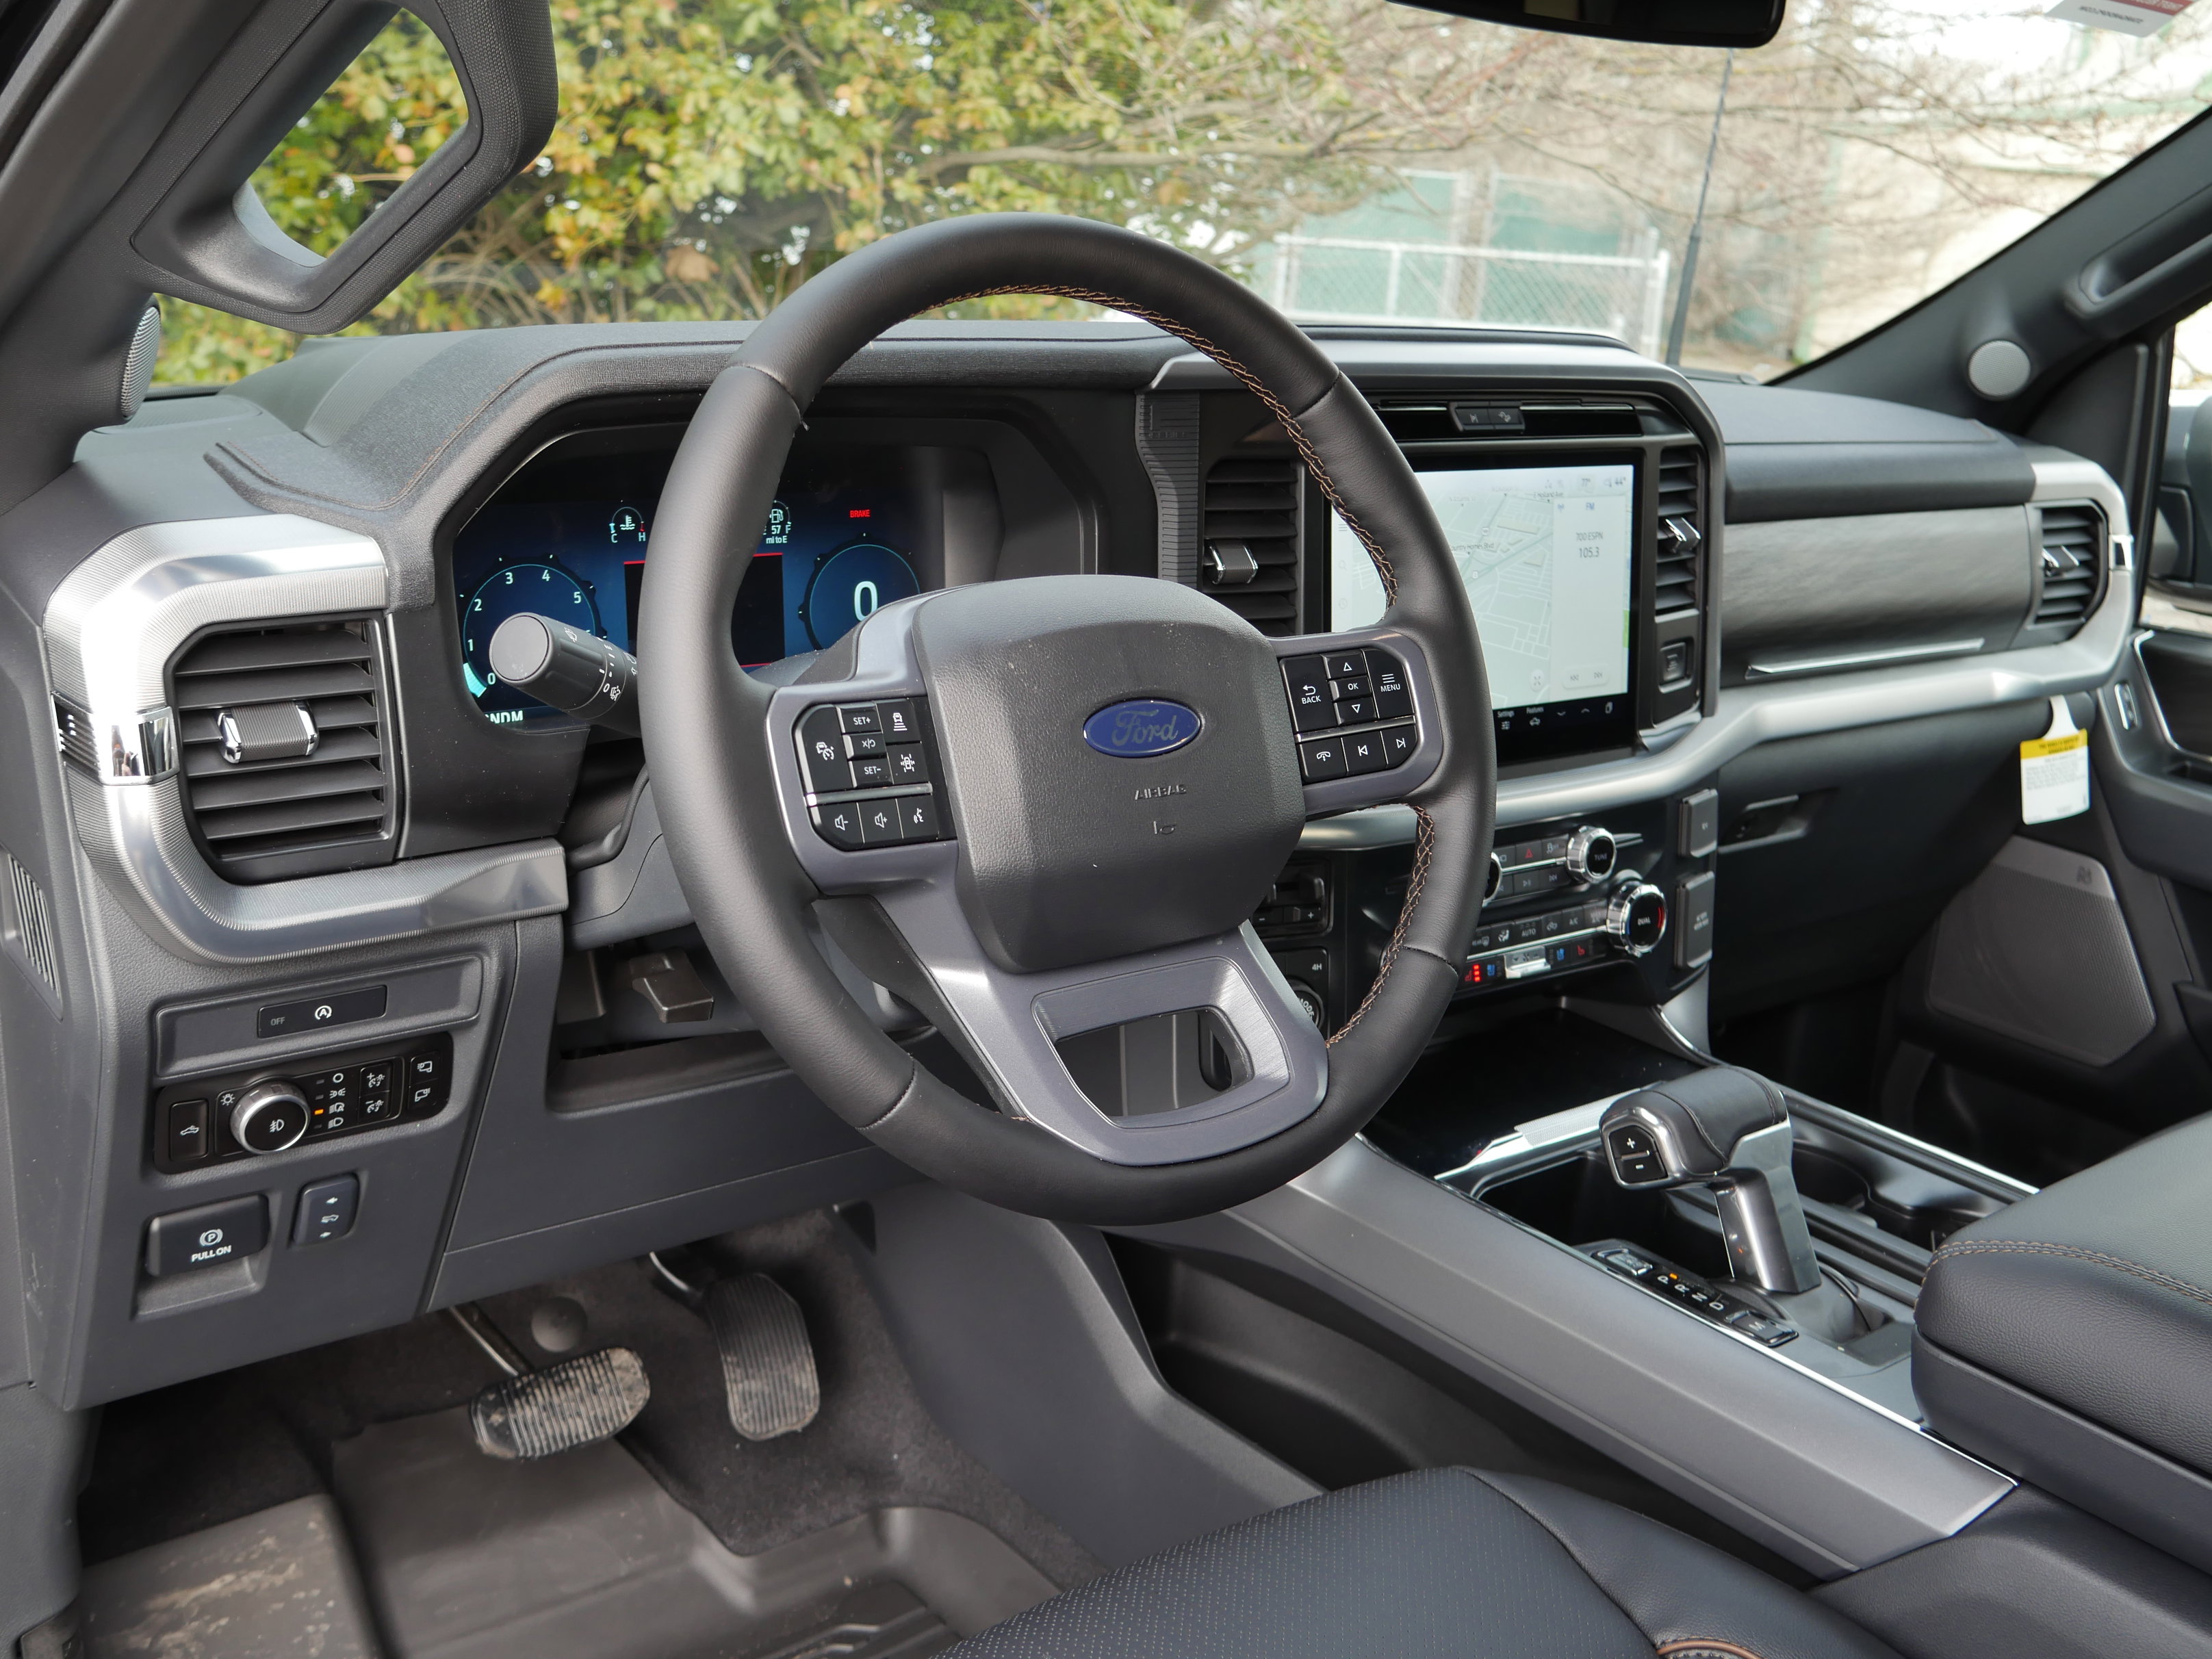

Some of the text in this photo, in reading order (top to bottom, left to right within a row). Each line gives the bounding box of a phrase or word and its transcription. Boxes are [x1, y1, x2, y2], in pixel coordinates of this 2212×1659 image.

[1586, 502, 1595, 511] FM
[850, 510, 871, 518] BRAKE
[771, 525, 781, 535] 57
[786, 525, 791, 534] F
[611, 533, 618, 543] C
[639, 532, 645, 541] H
[1589, 532, 1603, 541] ESPN
[1579, 548, 1599, 558] 105.3
[506, 572, 513, 584] 3
[542, 570, 550, 582] 4
[574, 592, 582, 604] 5
[854, 580, 878, 621] 0
[474, 599, 482, 611] 2
[467, 639, 474, 651] 1
[487, 673, 496, 684] 0
[1348, 682, 1359, 691] OK
[1380, 684, 1401, 693] MENU
[1301, 695, 1321, 704] BACK
[485, 710, 524, 723] NDM
[1111, 708, 1179, 747] Ford
[1135, 784, 1187, 800] AIRBAG
[1638, 916, 1651, 925] DUAL
[1521, 928, 1536, 937] AUTO
[1312, 963, 1322, 971] 4H
[270, 1016, 285, 1026] OFF
[191, 1245, 232, 1263] PULL ON
[1657, 1275, 1724, 1311] P R N D
[1749, 1321, 1766, 1331] M
